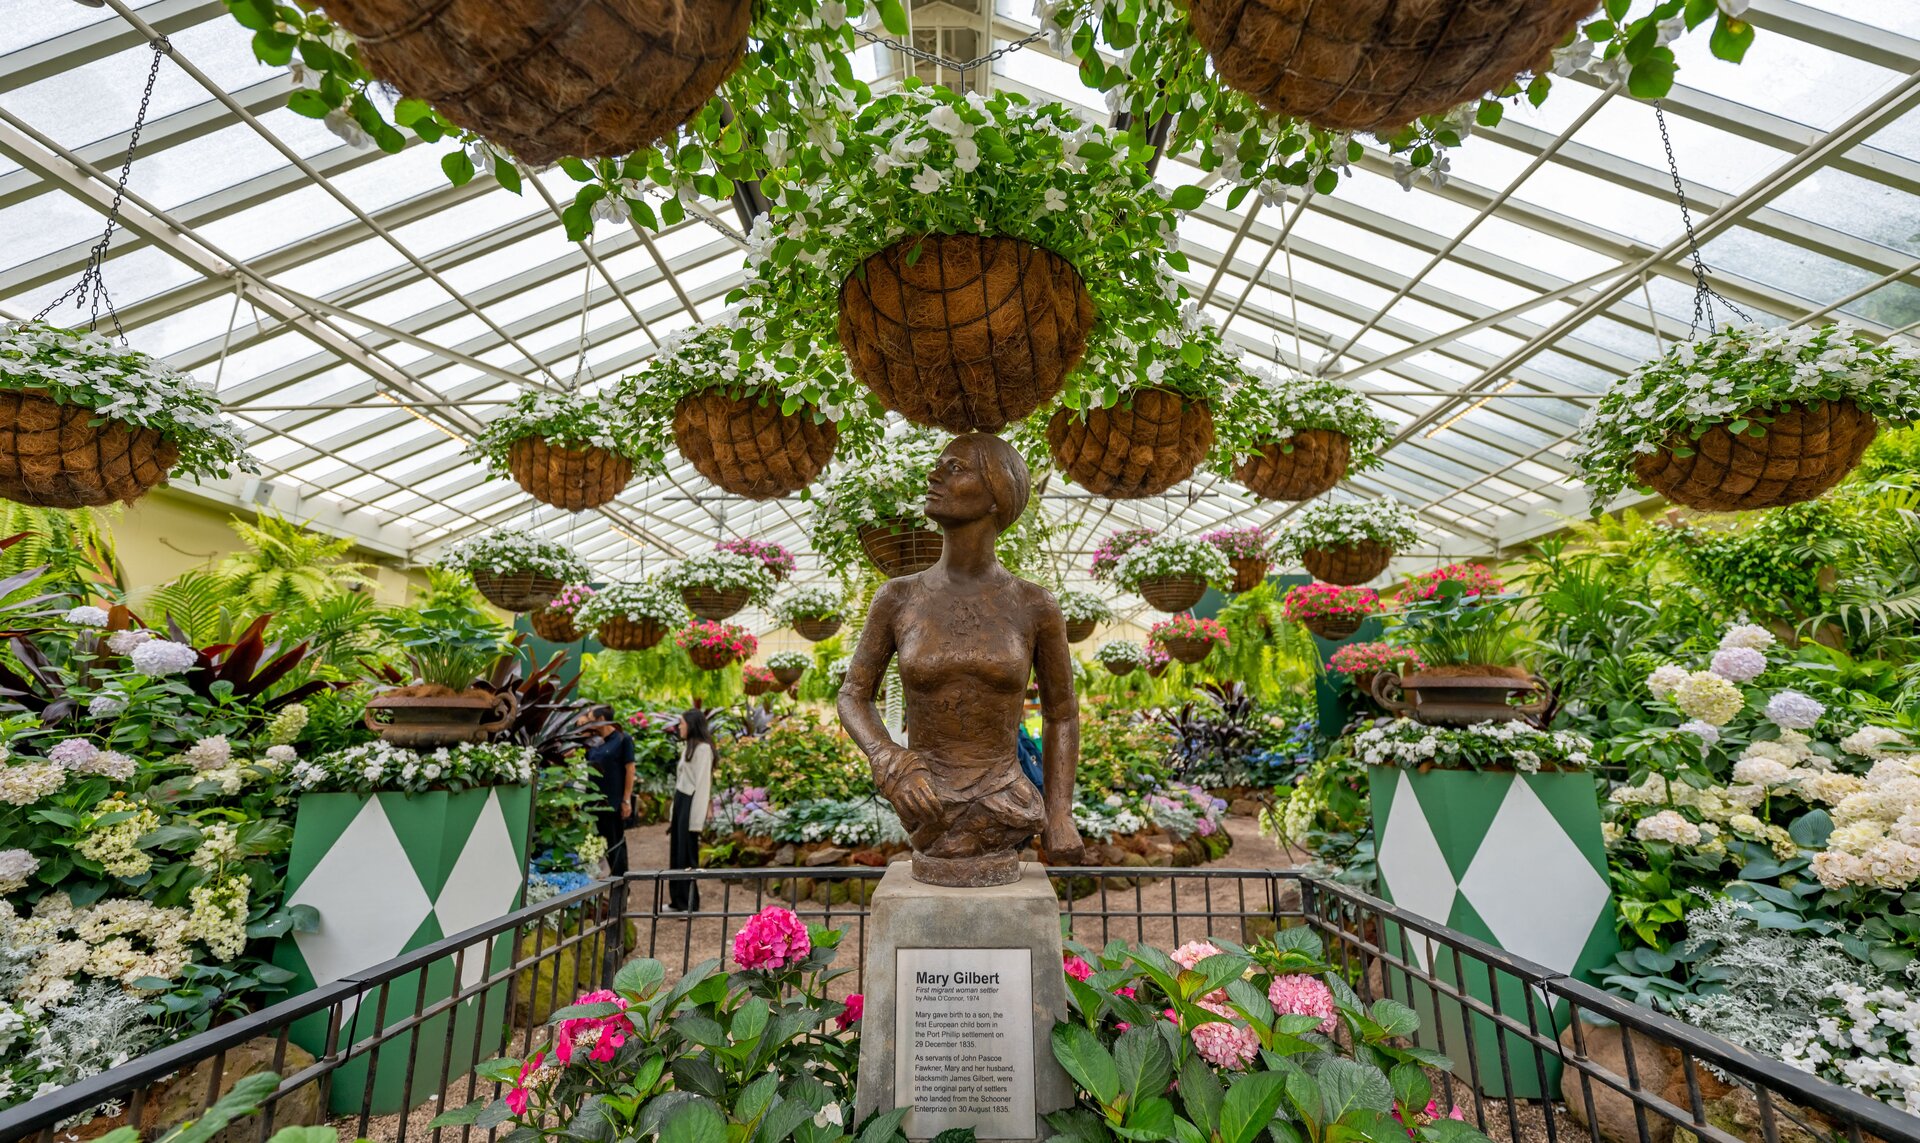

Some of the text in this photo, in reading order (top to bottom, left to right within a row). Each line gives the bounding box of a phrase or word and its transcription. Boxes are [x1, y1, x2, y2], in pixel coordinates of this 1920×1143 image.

[916, 972, 1000, 986] Mary Gilbert
[945, 1065, 960, 1073] Mary
[934, 1085, 957, 1093] original
[959, 1085, 974, 1093] party
[915, 1106, 947, 1114] Enterprize
[968, 1106, 991, 1114] August
